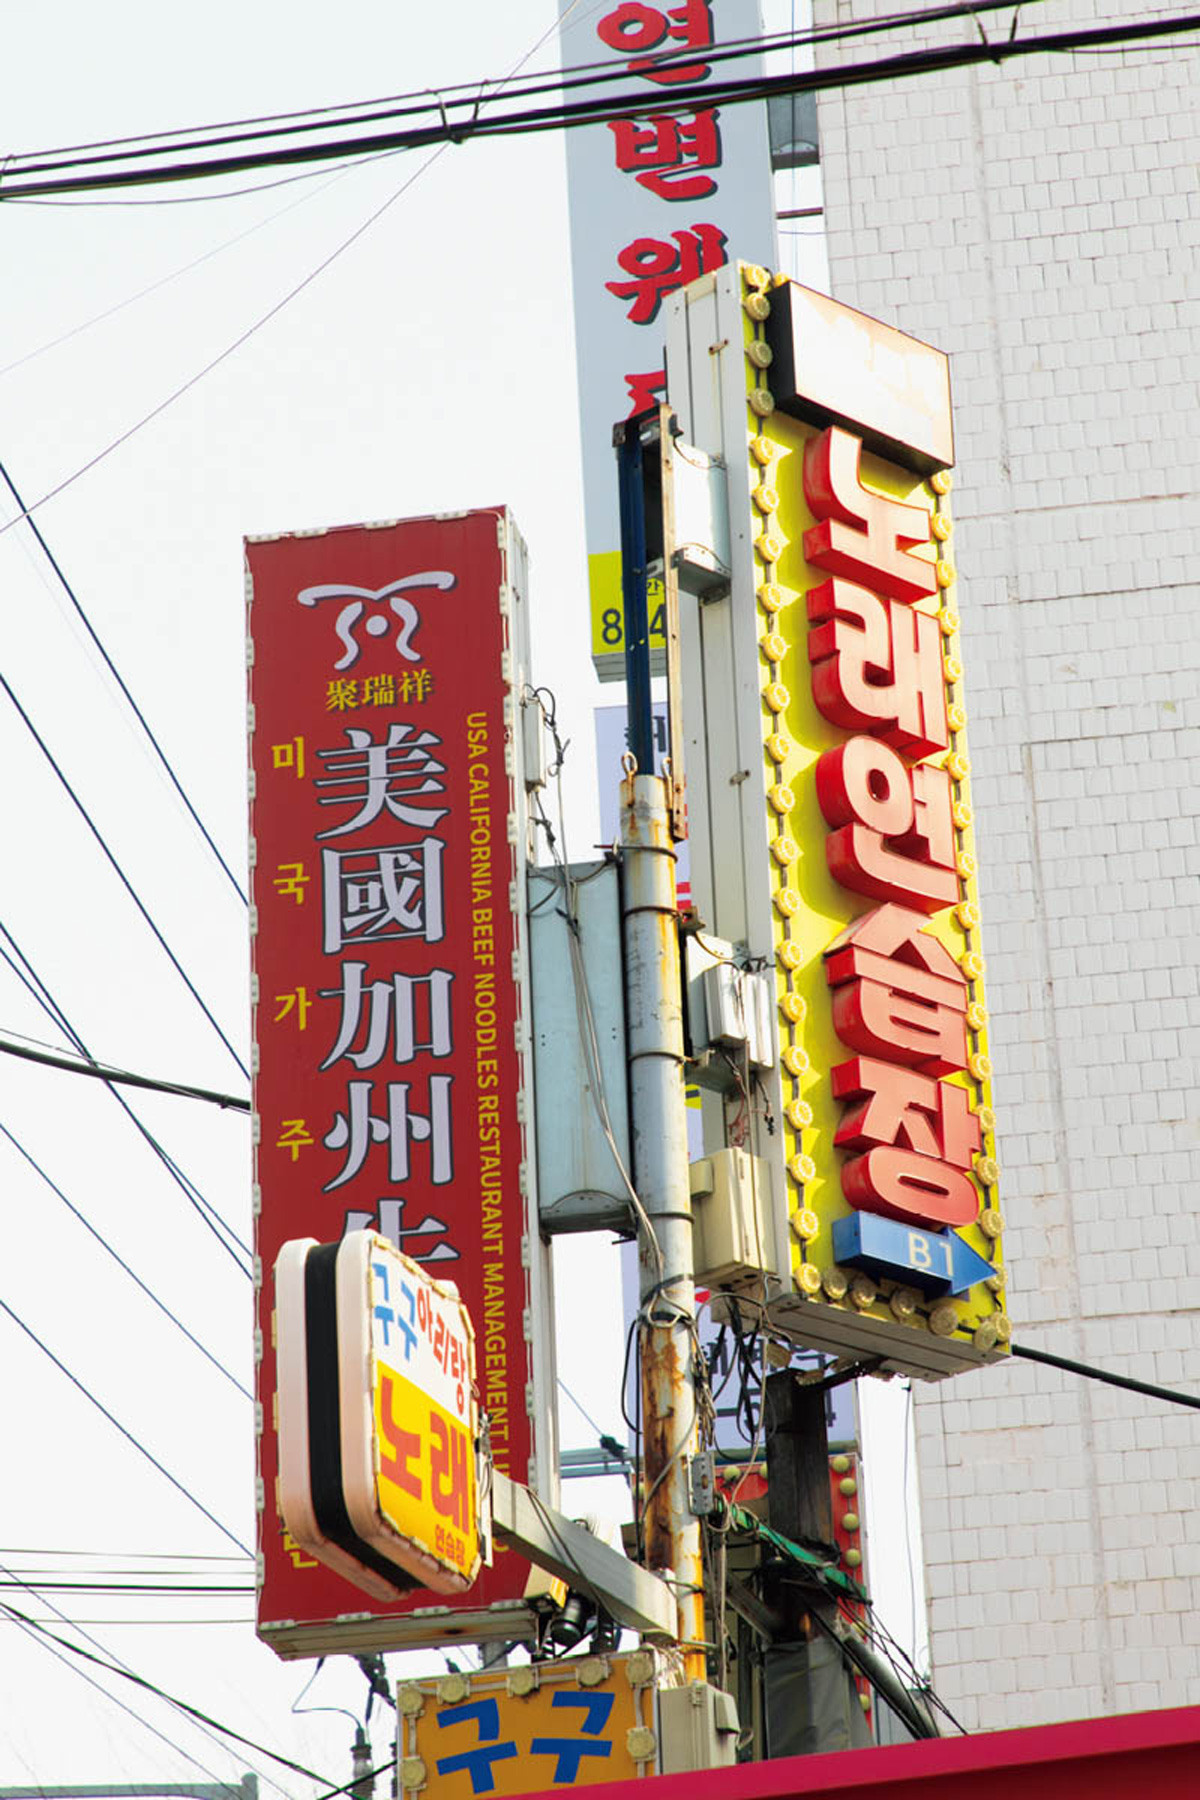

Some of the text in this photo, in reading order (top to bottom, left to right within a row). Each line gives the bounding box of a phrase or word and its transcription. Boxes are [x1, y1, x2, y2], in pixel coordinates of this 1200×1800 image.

[326, 669, 434, 711] 聚瑞祥
[467, 712, 488, 759] USA
[469, 763, 492, 903] CALIFORNIA
[803, 426, 982, 1228] 노래연습장
[472, 908, 494, 965] BEEF
[474, 973, 498, 1089] NOODLES
[478, 1095, 503, 1255] RESTAURANT
[908, 1232, 954, 1277] B1
[372, 1263, 466, 1416] 구구 아리랑
[483, 1263, 509, 1441] MANAGEMENT
[379, 1375, 470, 1536] 노래
[436, 1691, 615, 1795] 구구
